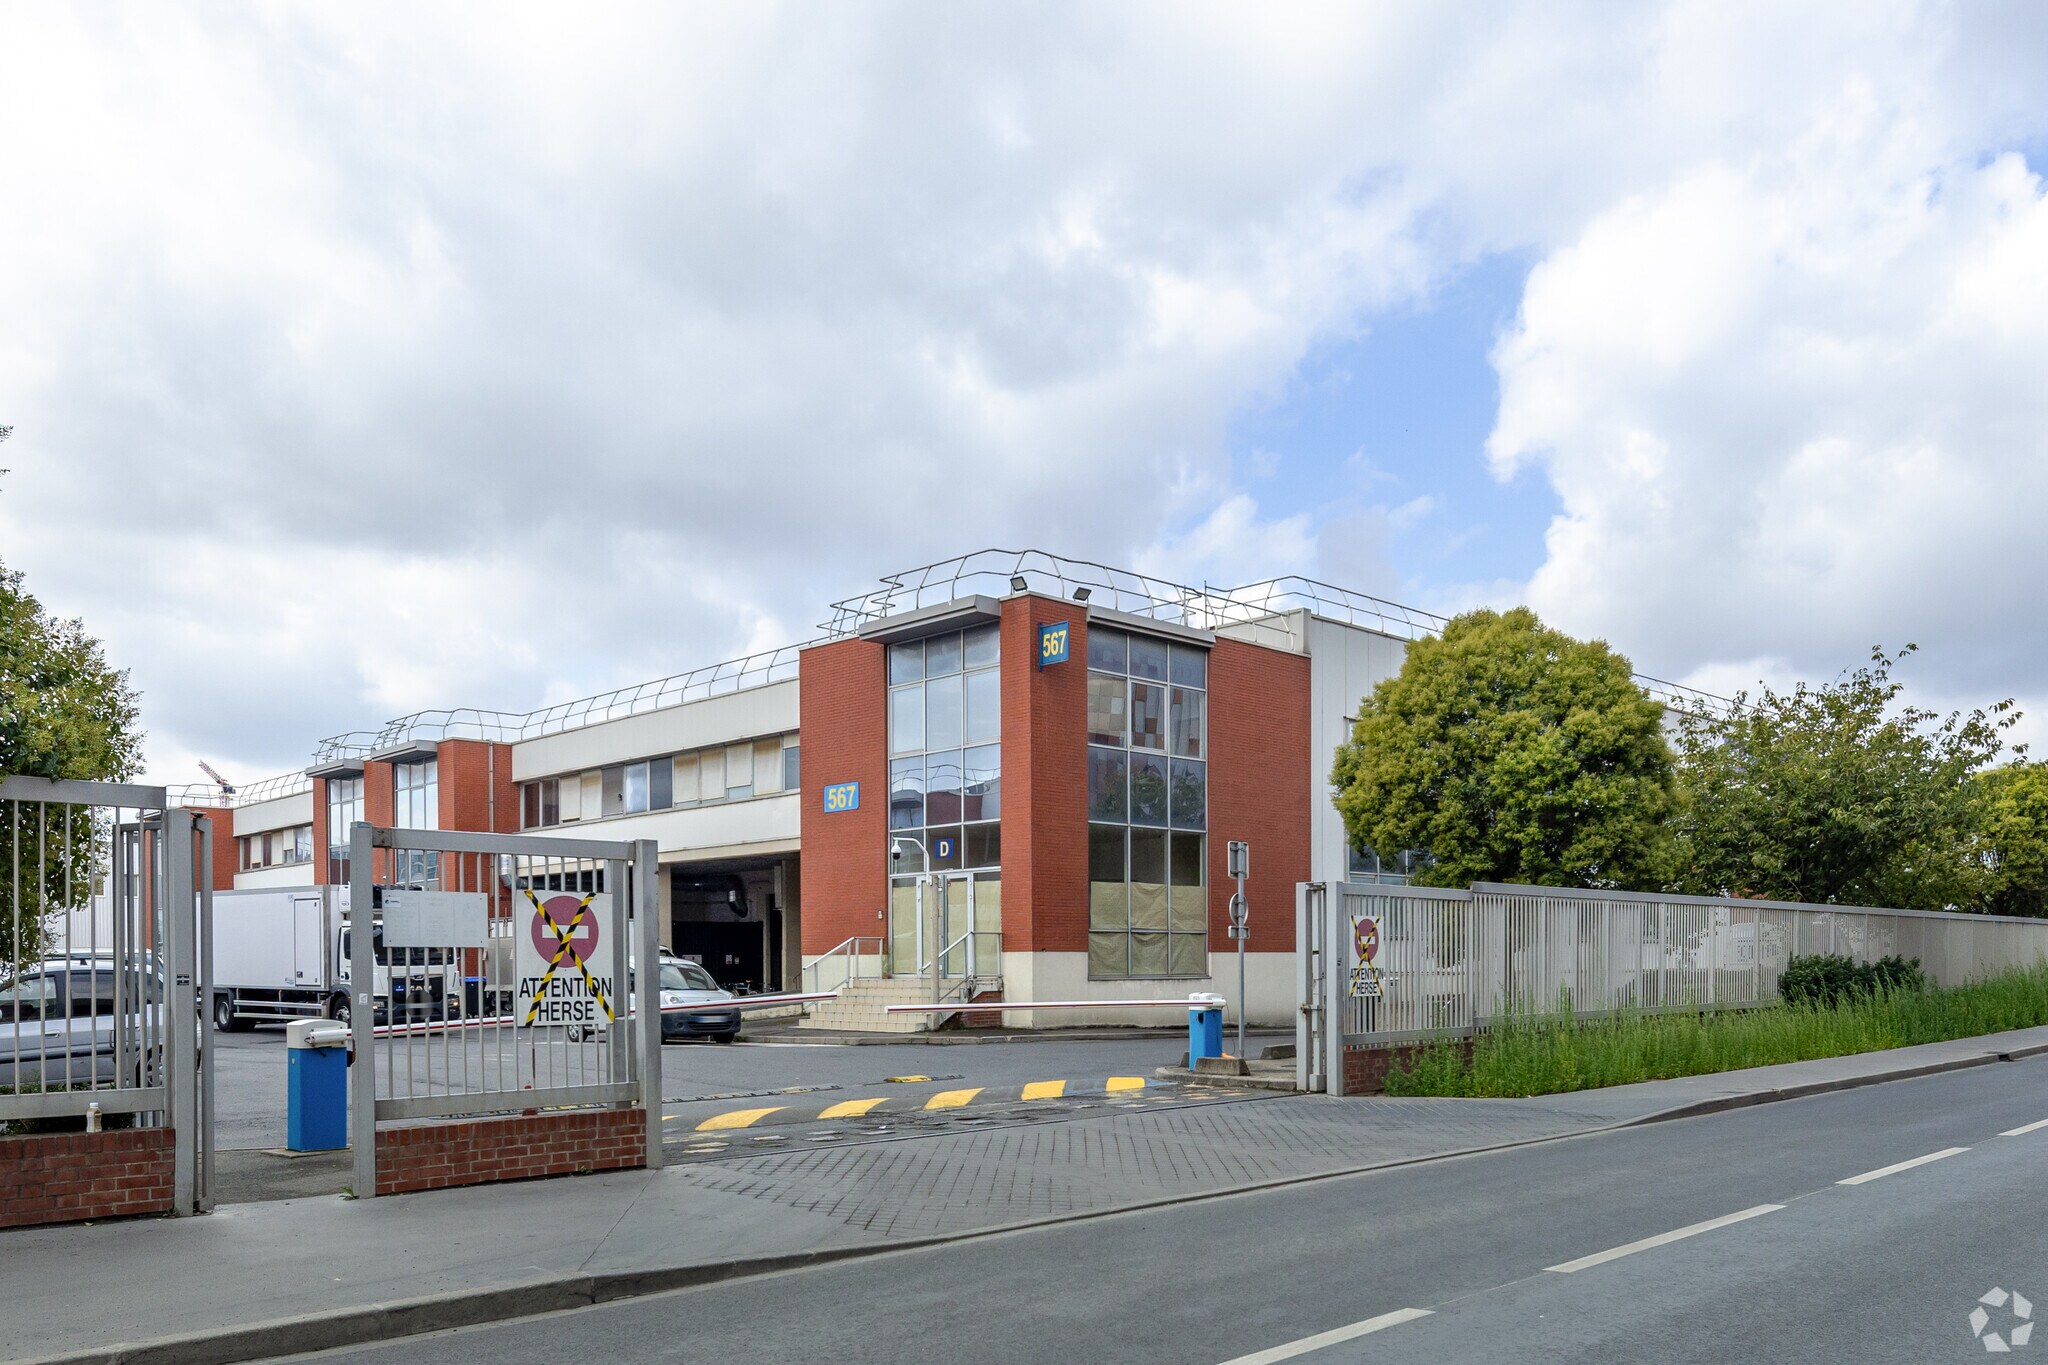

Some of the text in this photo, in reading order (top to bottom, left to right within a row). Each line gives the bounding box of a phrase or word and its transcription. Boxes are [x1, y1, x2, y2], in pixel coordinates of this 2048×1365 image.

[1042, 629, 1067, 657] 567
[828, 785, 856, 809] 567
[940, 841, 949, 857] D
[1356, 981, 1377, 994] HERSE
[538, 1000, 595, 1022] HERSE
